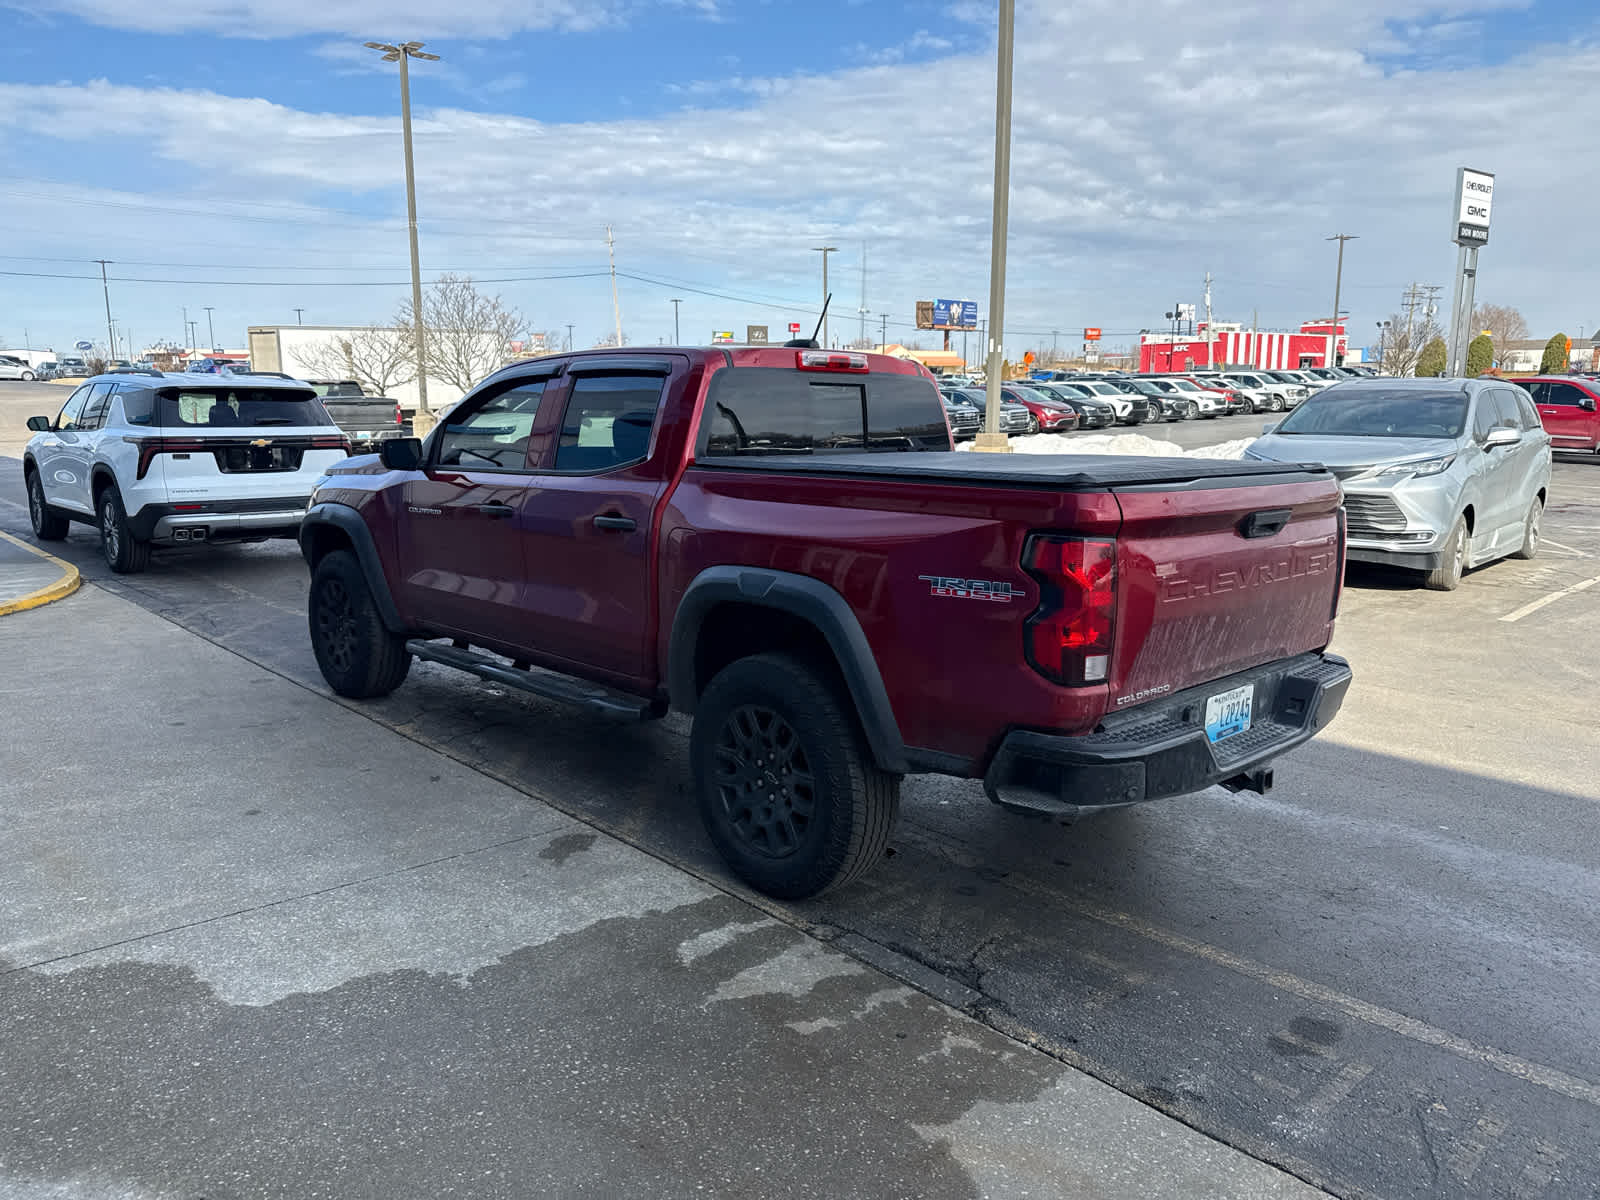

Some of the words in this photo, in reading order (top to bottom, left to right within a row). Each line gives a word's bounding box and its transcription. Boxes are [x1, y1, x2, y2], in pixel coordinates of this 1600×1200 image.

[1466, 181, 1492, 193] CHEVROLET
[1467, 205, 1487, 218] GMC
[1173, 344, 1190, 352] KFC
[1162, 552, 1336, 602] CHEVROLET
[930, 587, 1012, 603] BOSS
[1116, 684, 1170, 705] COLORADO
